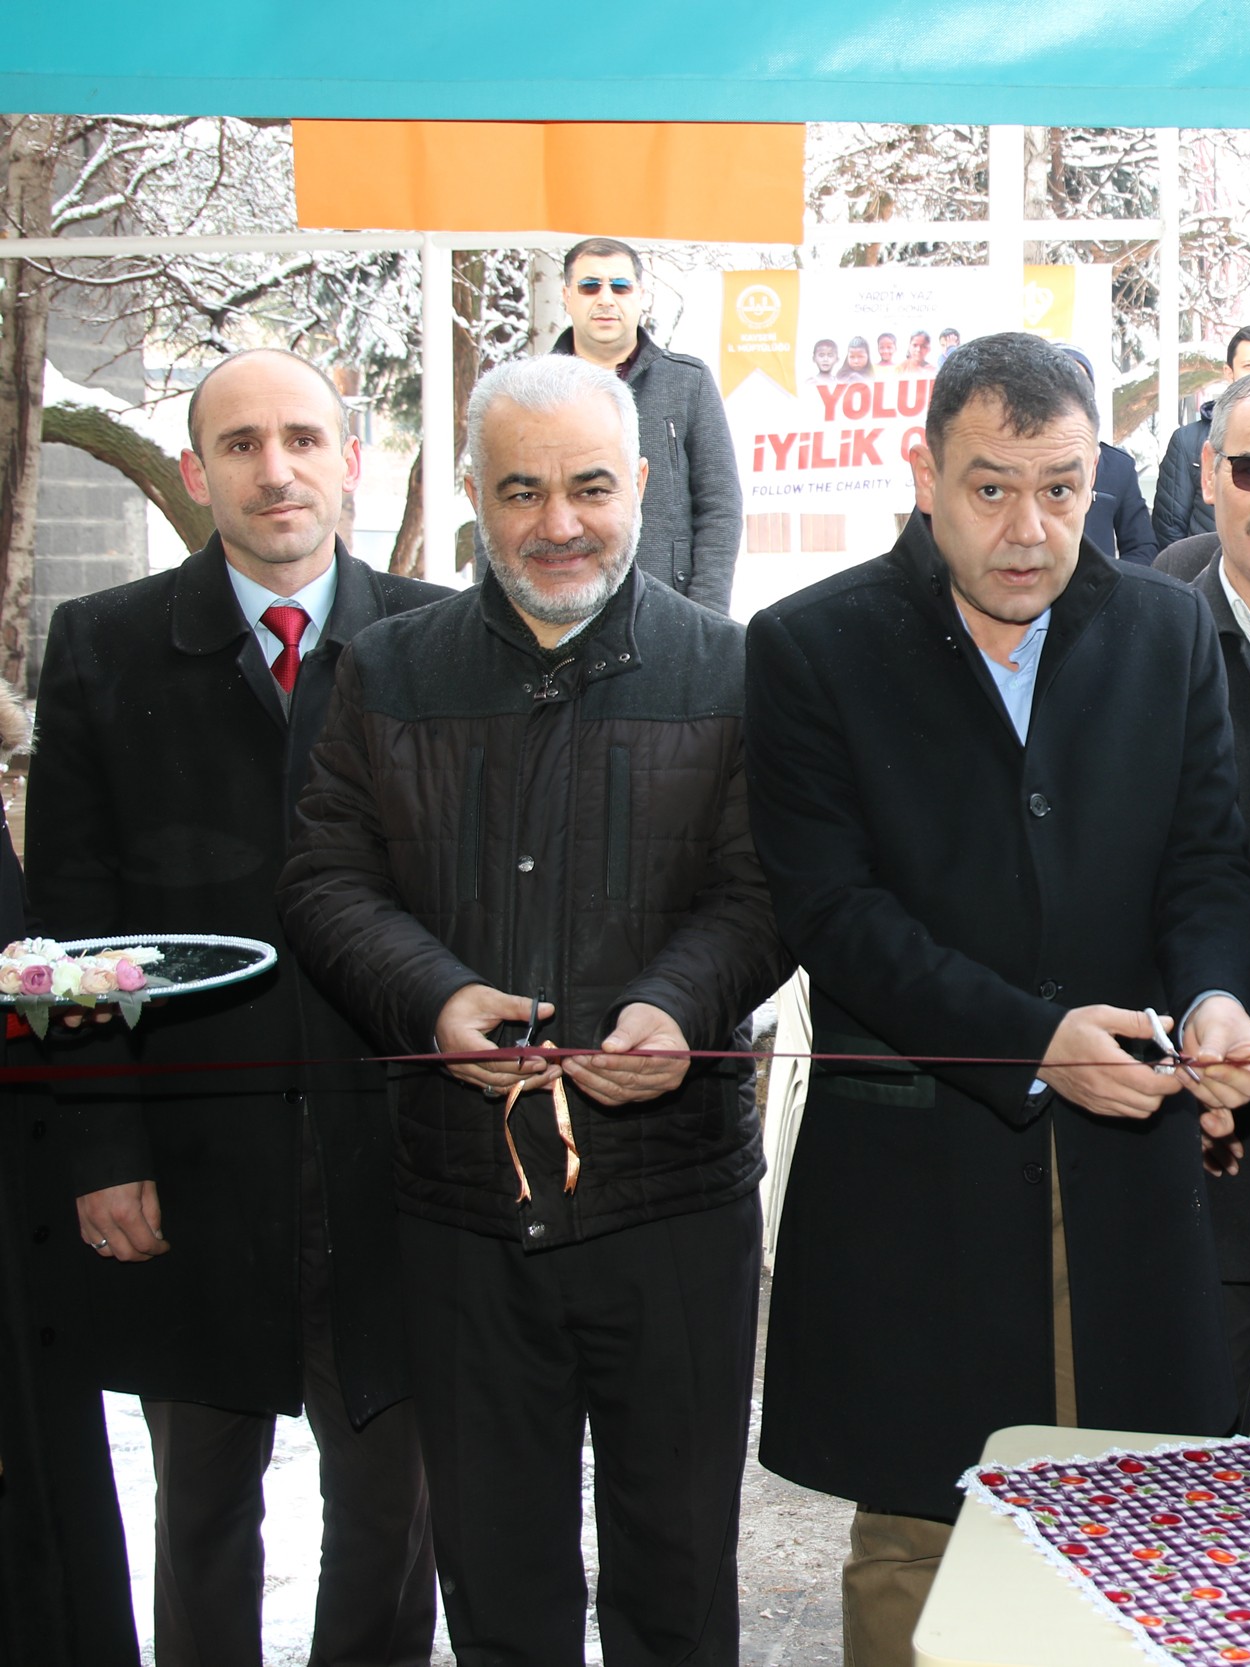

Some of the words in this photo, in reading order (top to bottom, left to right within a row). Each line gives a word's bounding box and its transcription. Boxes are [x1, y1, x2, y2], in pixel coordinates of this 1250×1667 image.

[816, 379, 936, 422] YOLU
[752, 484, 804, 496] FOLLOW
[808, 482, 832, 493] THE
[836, 479, 892, 492] CHARITY
